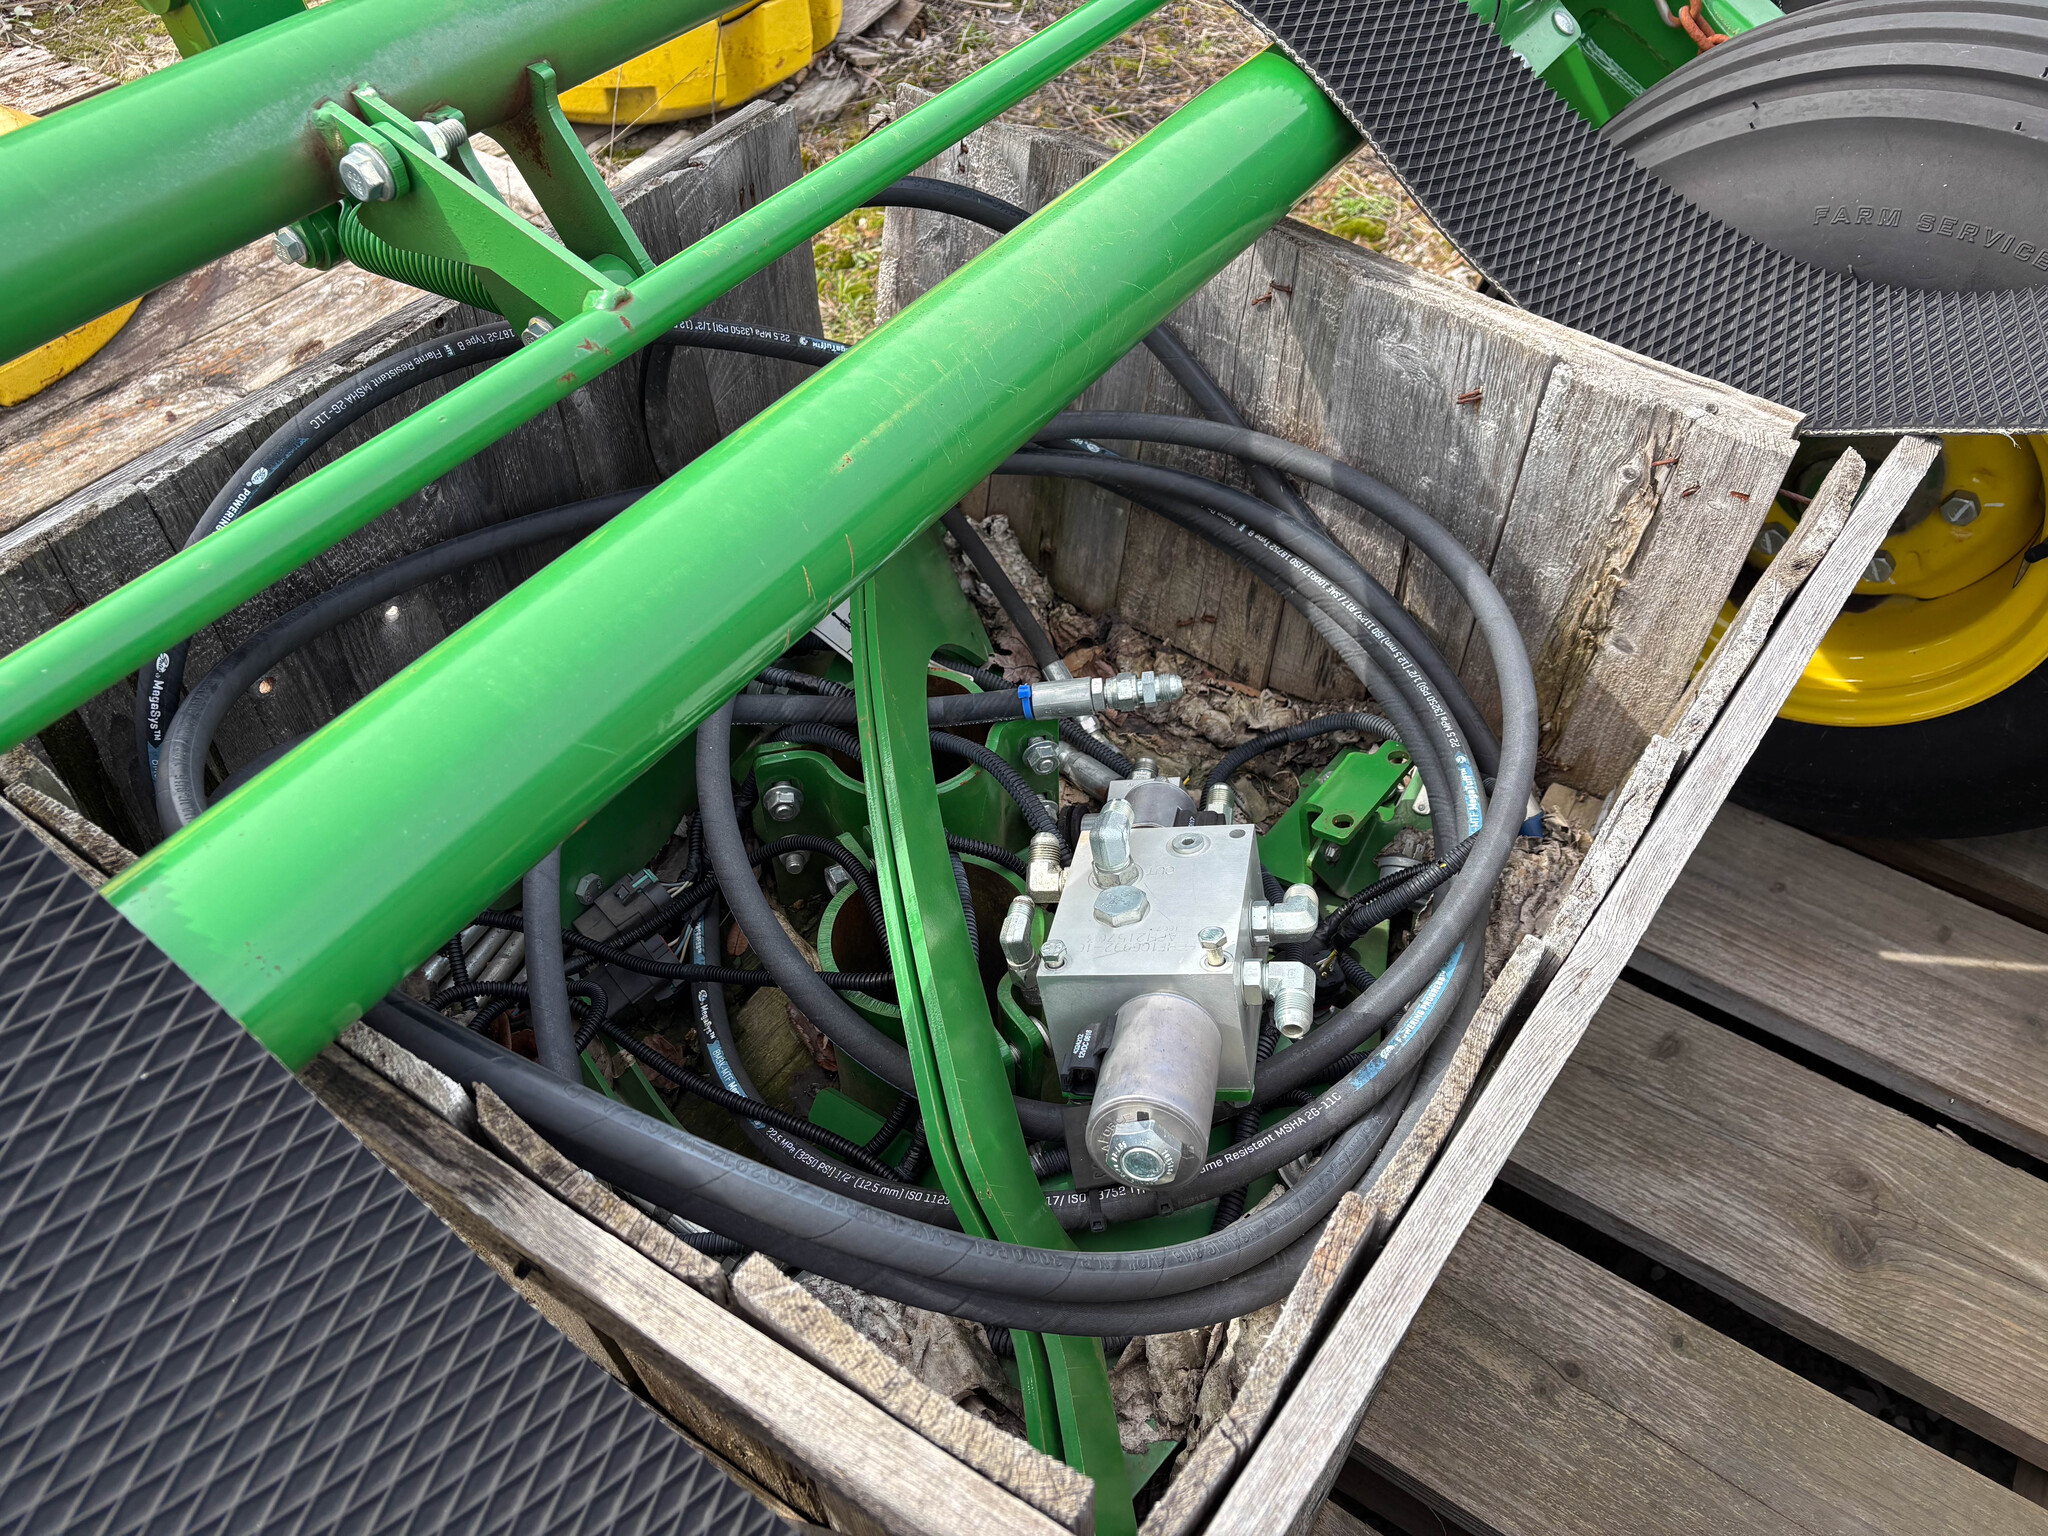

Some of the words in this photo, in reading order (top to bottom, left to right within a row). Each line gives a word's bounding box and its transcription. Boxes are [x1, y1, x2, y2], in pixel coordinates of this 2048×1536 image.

[1813, 204, 1902, 227] FARM
[1916, 212, 2048, 271] SERVICE
[755, 328, 772, 339] MPa
[773, 332, 791, 343] 22.5
[456, 341, 465, 351] B
[465, 334, 488, 348] Type
[414, 348, 443, 364] Flame
[373, 361, 415, 391] Resistant
[345, 379, 373, 405] MSHA
[1254, 534, 1270, 548] Type
[1268, 543, 1291, 561] 18752
[1289, 558, 1304, 571] ISO
[1325, 586, 1341, 599] SAE
[1341, 599, 1357, 613] R17
[1371, 627, 1385, 640] ISO
[1440, 715, 1454, 733] MPa
[1449, 731, 1460, 748] 22.5
[1224, 1133, 1275, 1164] Resistant
[1275, 1116, 1306, 1139] MSHA
[1304, 1092, 1342, 1122] 2G-11C
[766, 1127, 783, 1144] 22.5
[780, 1138, 796, 1153] MPa
[904, 1191, 922, 1202] ISO
[1068, 1193, 1087, 1205] ISO
